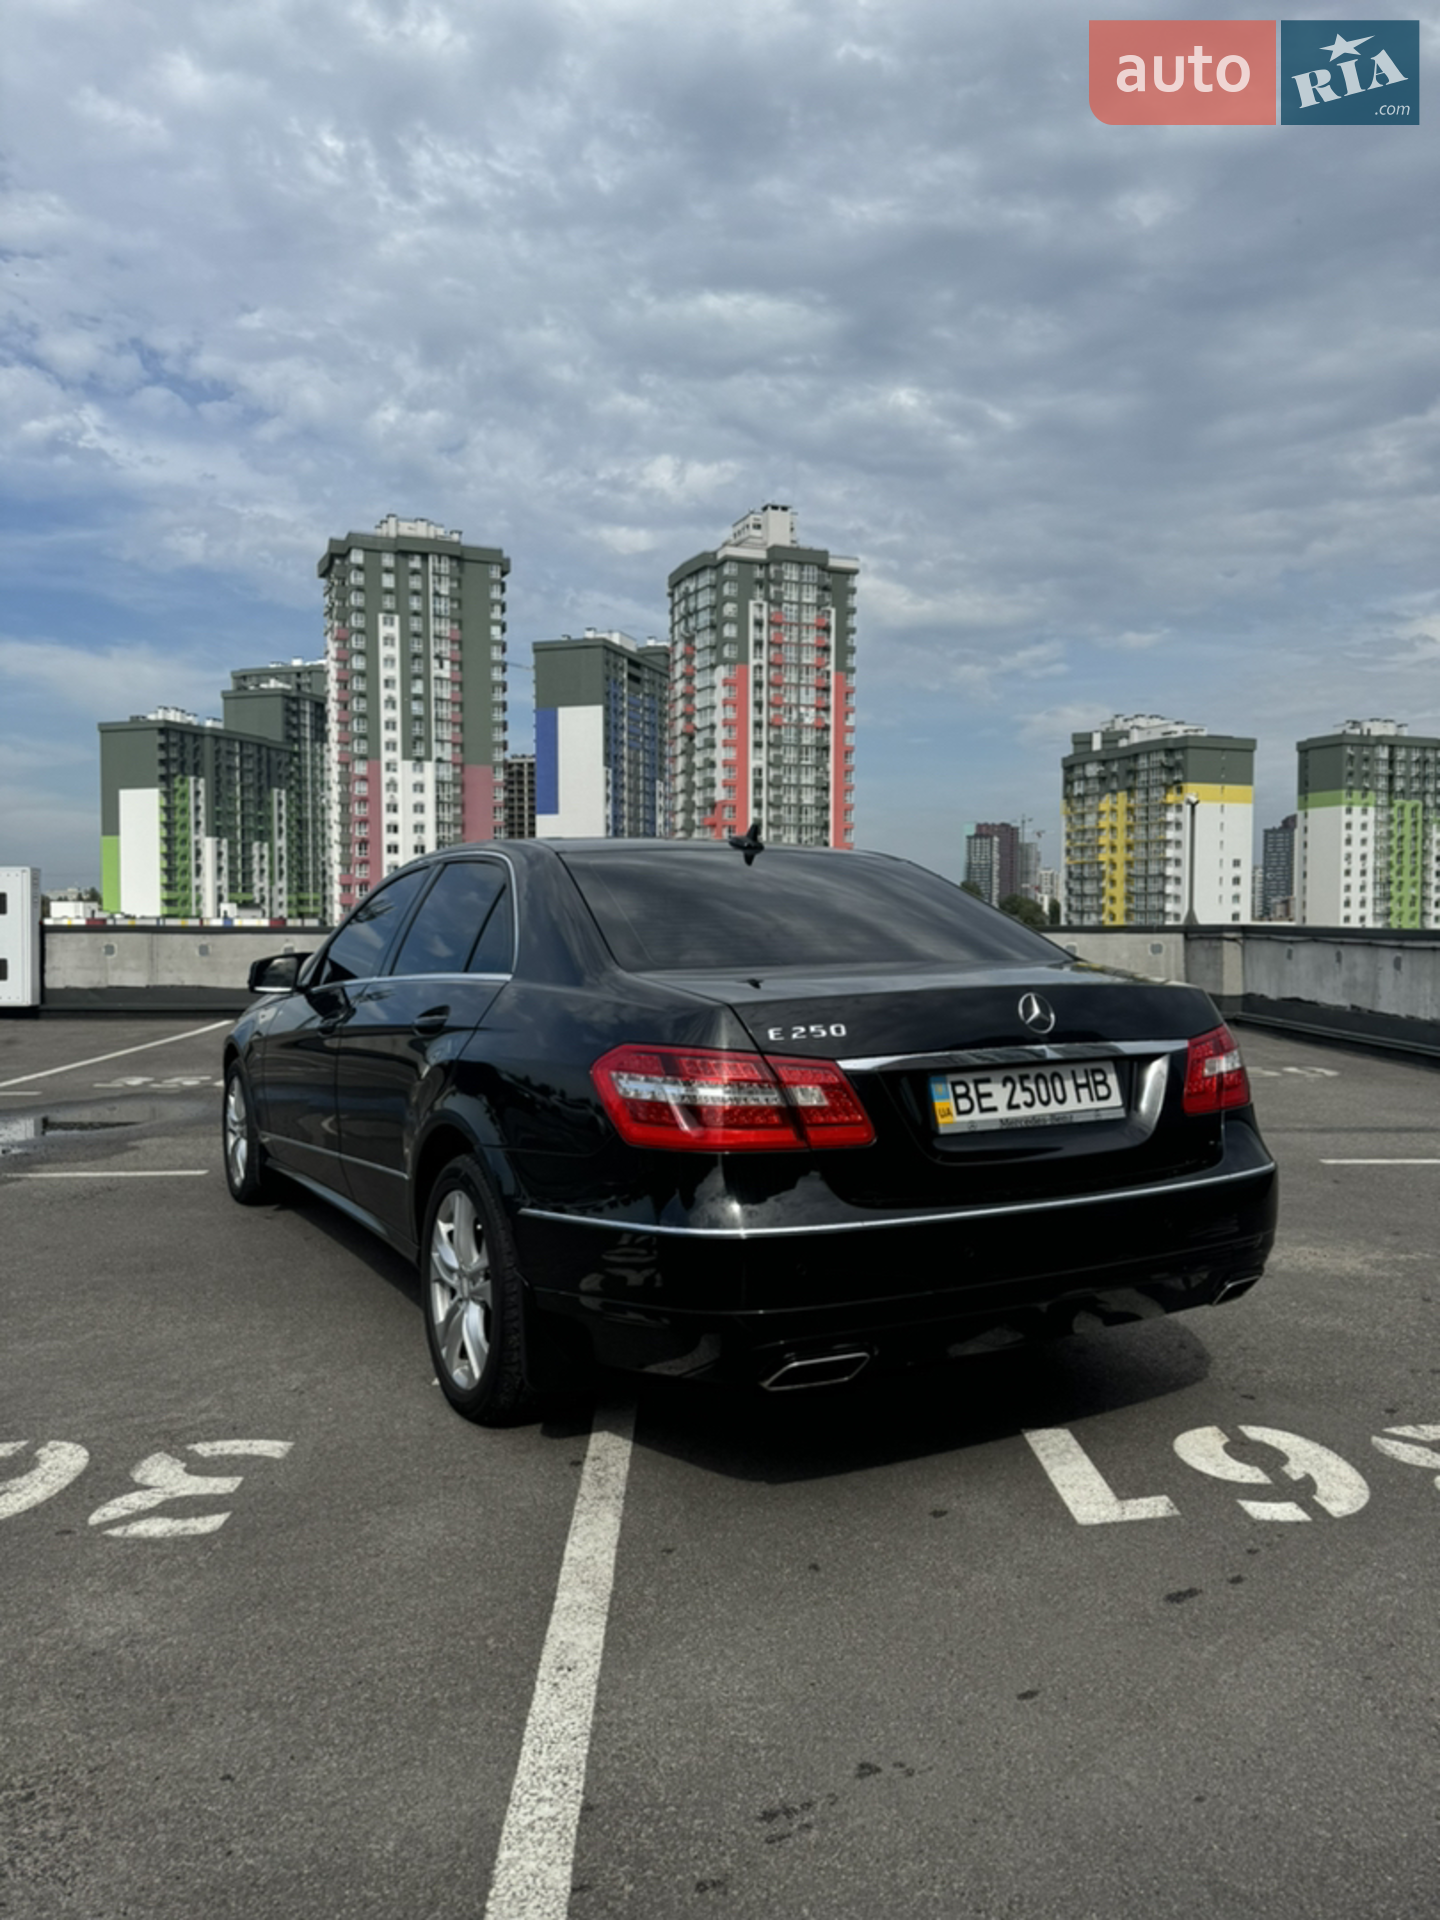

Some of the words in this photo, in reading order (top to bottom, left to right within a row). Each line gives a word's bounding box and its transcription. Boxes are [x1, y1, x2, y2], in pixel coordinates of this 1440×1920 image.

[767, 1027, 784, 1041] E
[791, 1023, 847, 1040] 250
[950, 1077, 998, 1116] BE
[1002, 1071, 1067, 1111] 2500
[1071, 1068, 1112, 1103] HB
